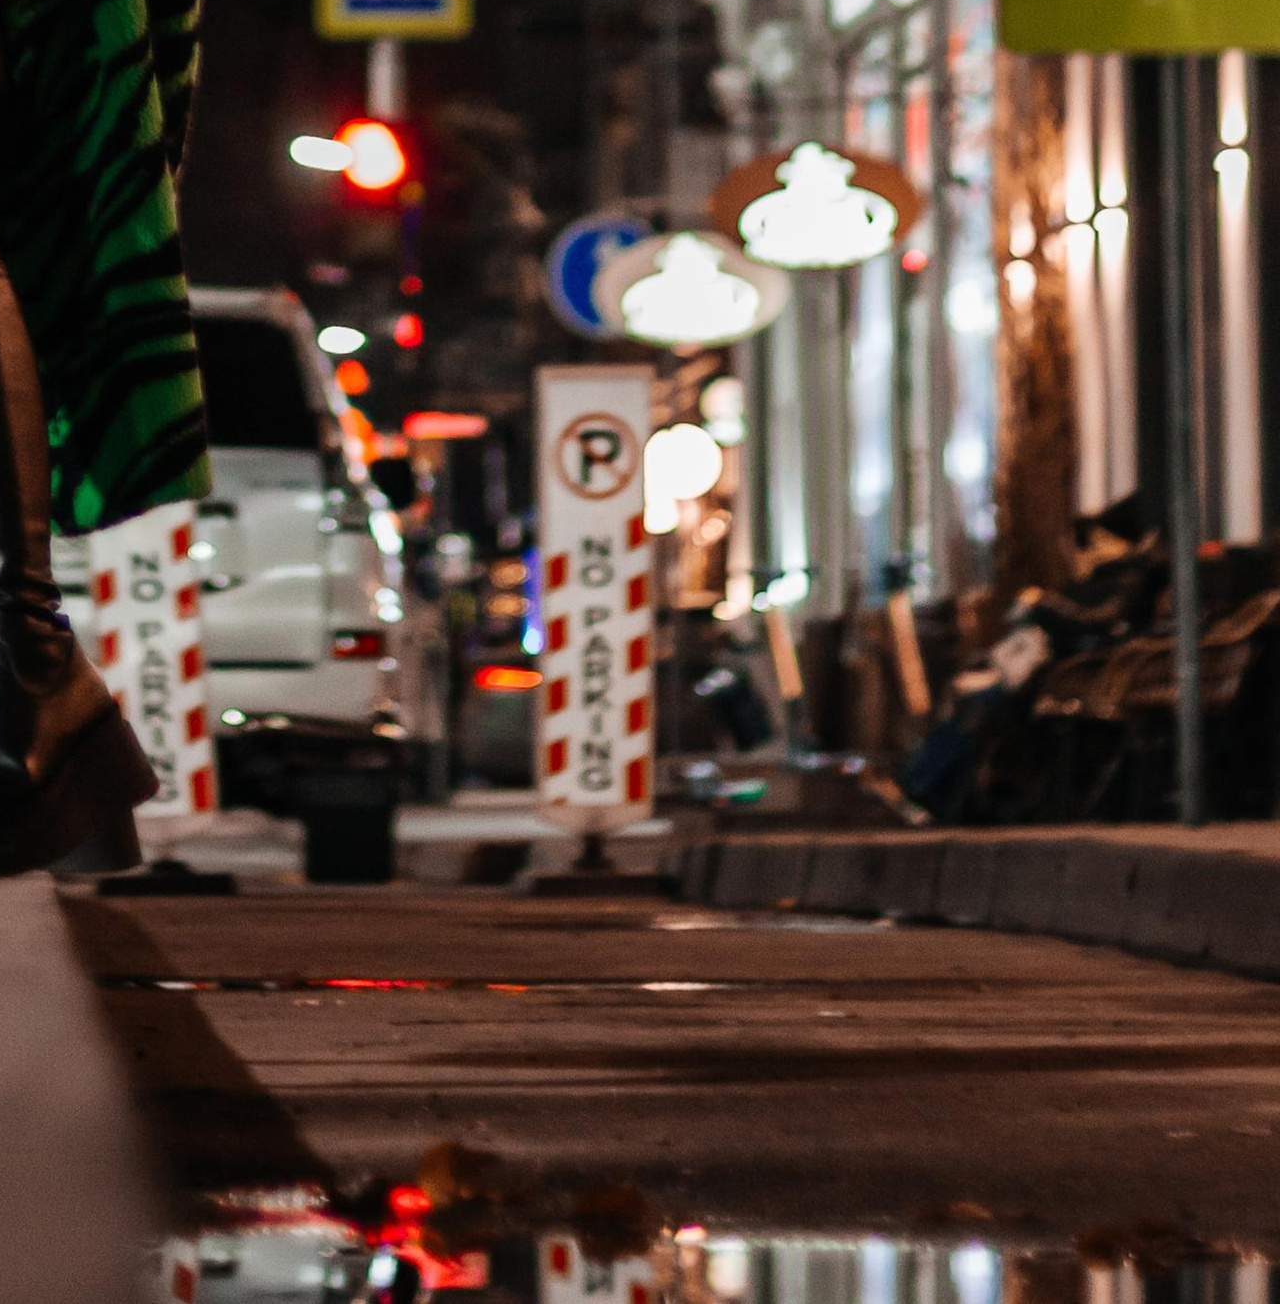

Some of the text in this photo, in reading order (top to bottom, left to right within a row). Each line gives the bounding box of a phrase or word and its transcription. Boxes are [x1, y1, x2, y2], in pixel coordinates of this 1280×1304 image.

[579, 429, 621, 484] P
[131, 553, 164, 602] NO
[580, 538, 613, 791] NO PARKING
